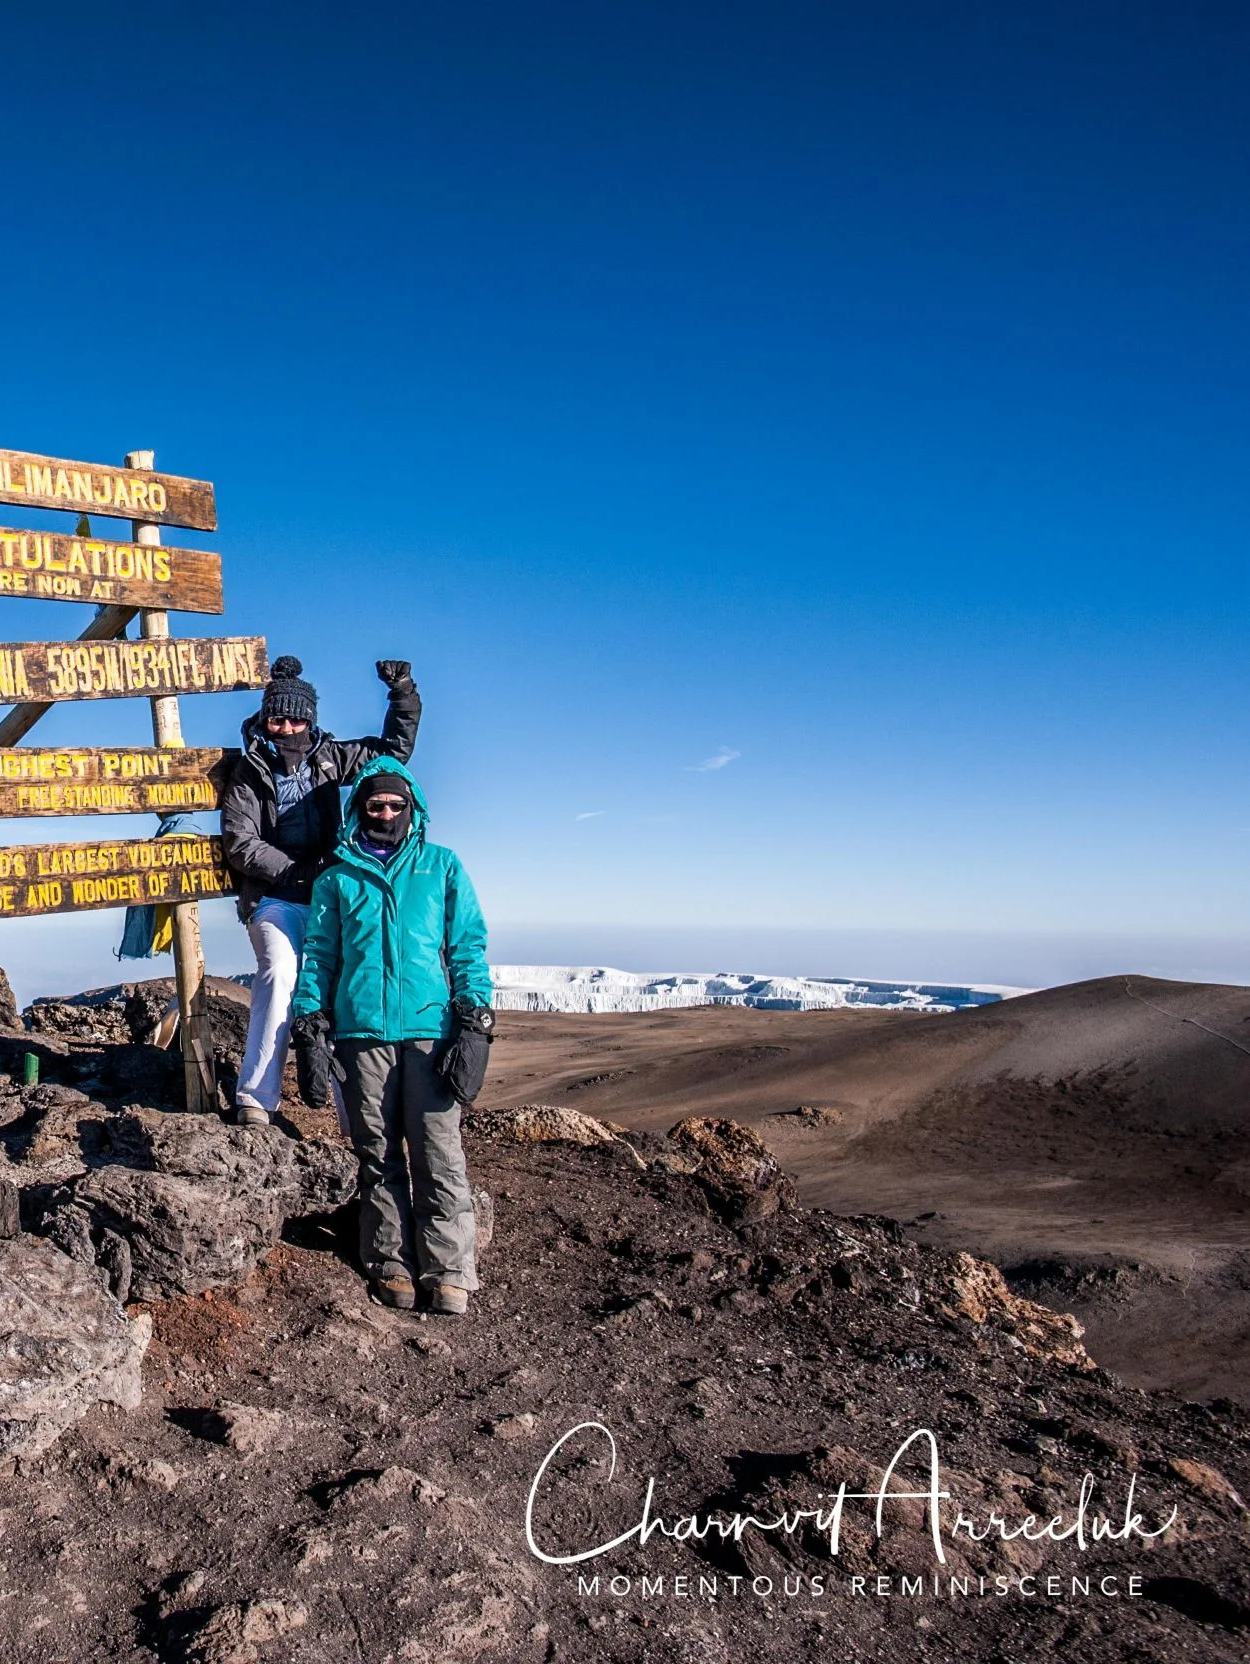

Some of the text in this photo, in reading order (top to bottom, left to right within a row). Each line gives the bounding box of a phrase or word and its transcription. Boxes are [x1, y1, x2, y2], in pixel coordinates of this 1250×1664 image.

[90, 580, 113, 599] AT
[212, 643, 261, 685] AMSL
[102, 754, 173, 777] POINT
[148, 781, 215, 805] MOUNTAIN
[37, 847, 120, 875] LARGEST
[127, 842, 223, 868] VOLCANOES
[27, 881, 62, 908] AND
[72, 875, 140, 905] WONDER
[148, 871, 170, 897] OF
[181, 868, 233, 894] AFRICA
